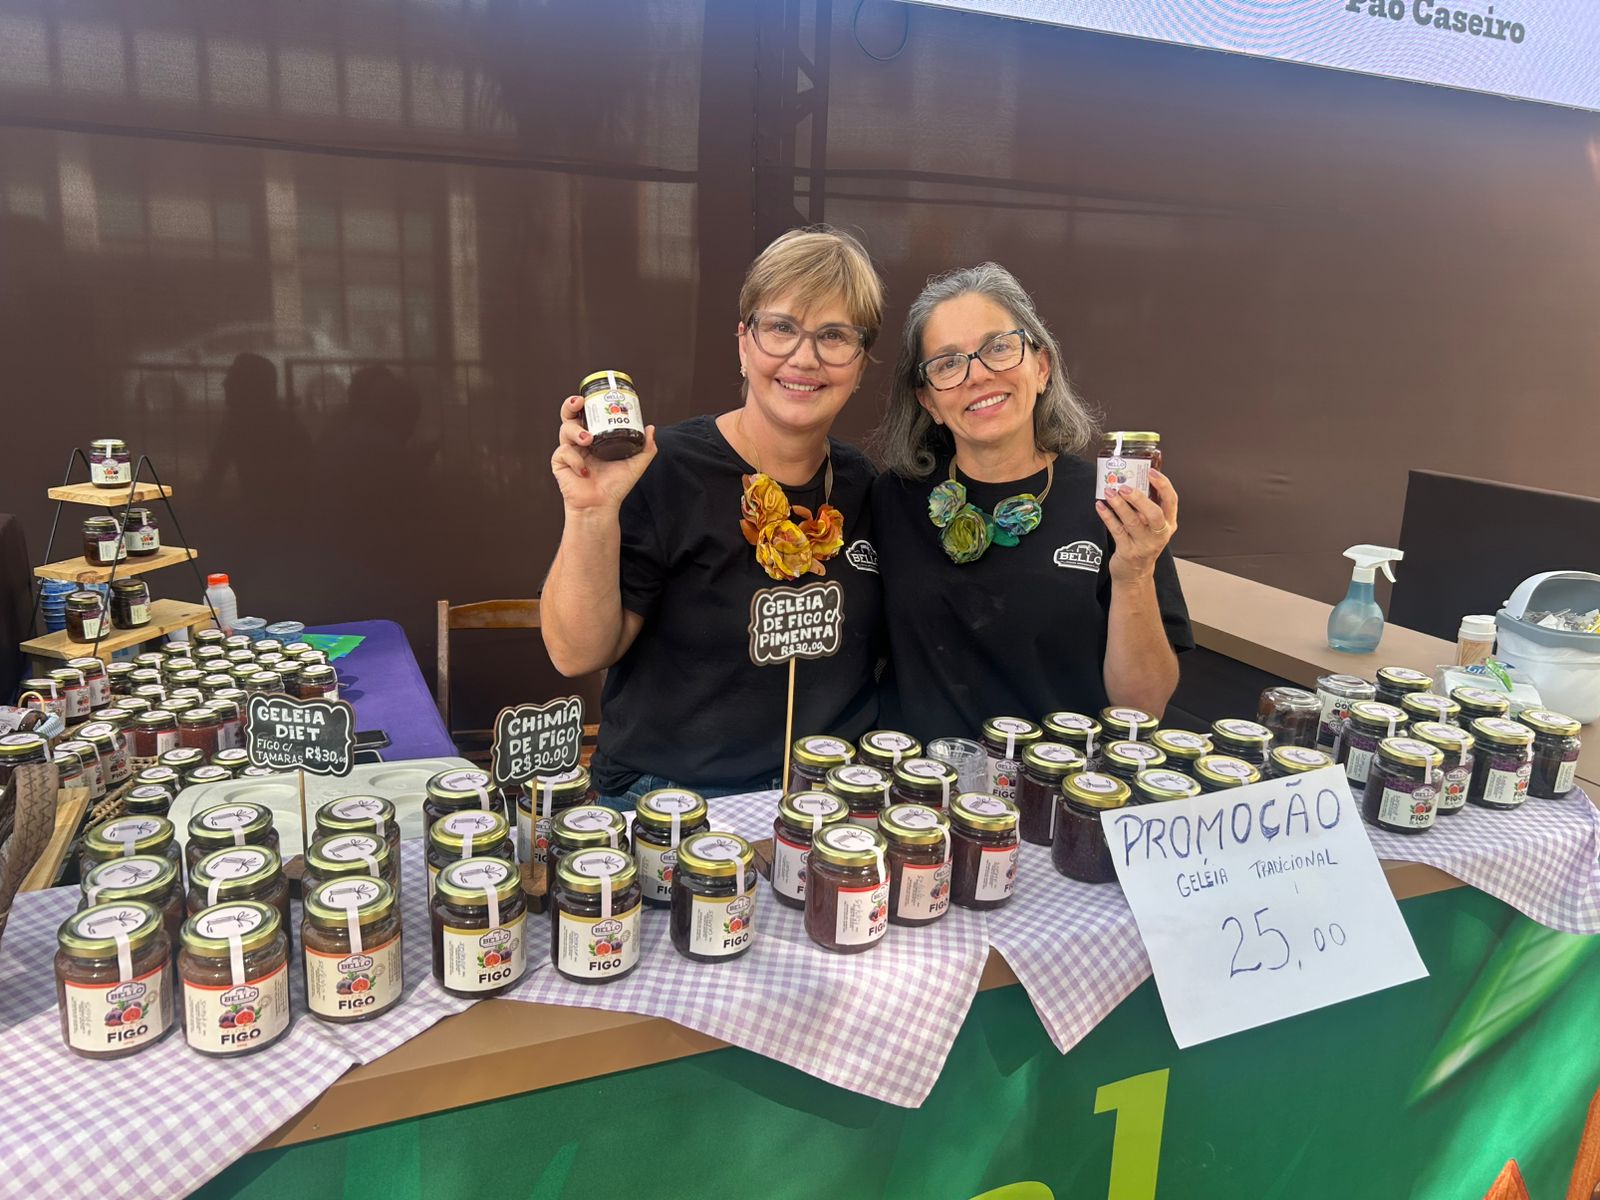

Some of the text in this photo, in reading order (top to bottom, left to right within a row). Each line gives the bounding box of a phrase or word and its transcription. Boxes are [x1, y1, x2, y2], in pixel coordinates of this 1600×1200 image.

[1412, 0, 1526, 44] Caseiro
[850, 553, 879, 566] BELL
[1058, 551, 1102, 566] BELLO
[763, 616, 784, 633] DE
[780, 641, 823, 656] R$30,00
[256, 738, 293, 753] FIGO C/
[509, 736, 532, 756] DE
[255, 750, 304, 764] TAMARAS
[511, 745, 569, 775] R$30,00
[1114, 779, 1341, 867] PROMOÇÃO
[1410, 814, 1430, 822] FIGO
[594, 924, 621, 934] BELLO
[723, 933, 749, 948] FIGO
[340, 960, 372, 971] BELLO
[589, 958, 622, 971] FIGO
[478, 967, 512, 984] FIGO
[110, 986, 145, 1001] BELLO
[223, 990, 258, 1003] BELLO
[338, 995, 376, 1010] FIGO
[106, 1024, 149, 1043] FIGO
[220, 1028, 261, 1045] FIGO
